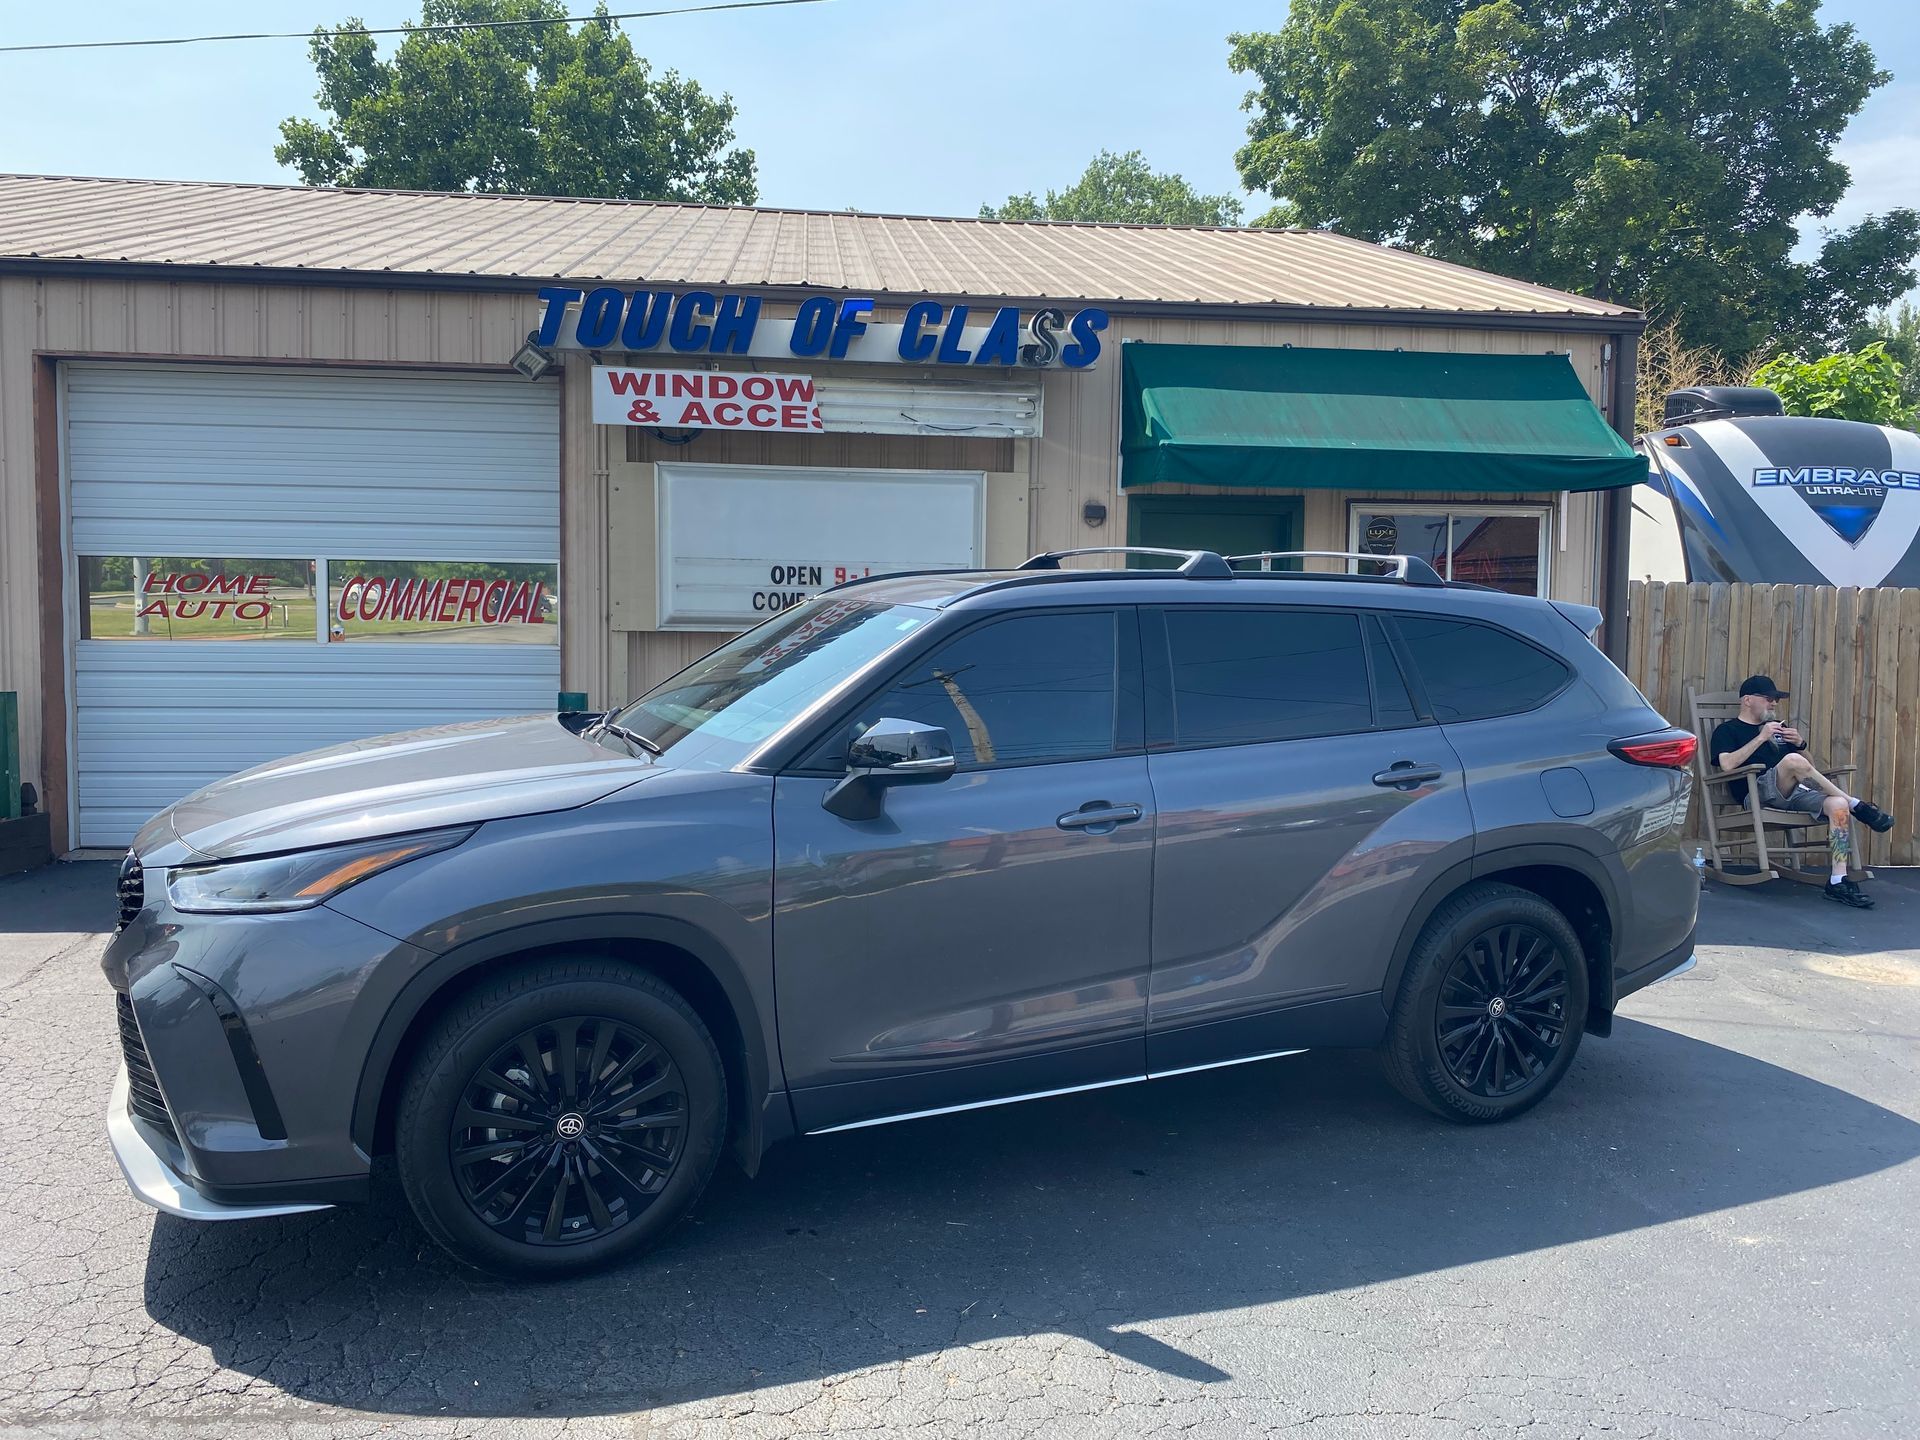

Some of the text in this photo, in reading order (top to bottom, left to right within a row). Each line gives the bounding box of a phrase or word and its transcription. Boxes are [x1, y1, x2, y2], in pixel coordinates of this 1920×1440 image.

[538, 286, 1109, 369] TOUCH OF CLASS
[607, 371, 815, 403] WINDOW
[626, 399, 661, 423] &
[1753, 467, 1920, 489] EMBRACE
[1806, 486, 1883, 497] ULTRA-LITE
[1369, 528, 1396, 539] LUXE
[142, 572, 275, 596] HOME
[770, 565, 822, 586] OPEN
[137, 600, 273, 622] AUTO
[337, 576, 546, 625] COMMERCIAL
